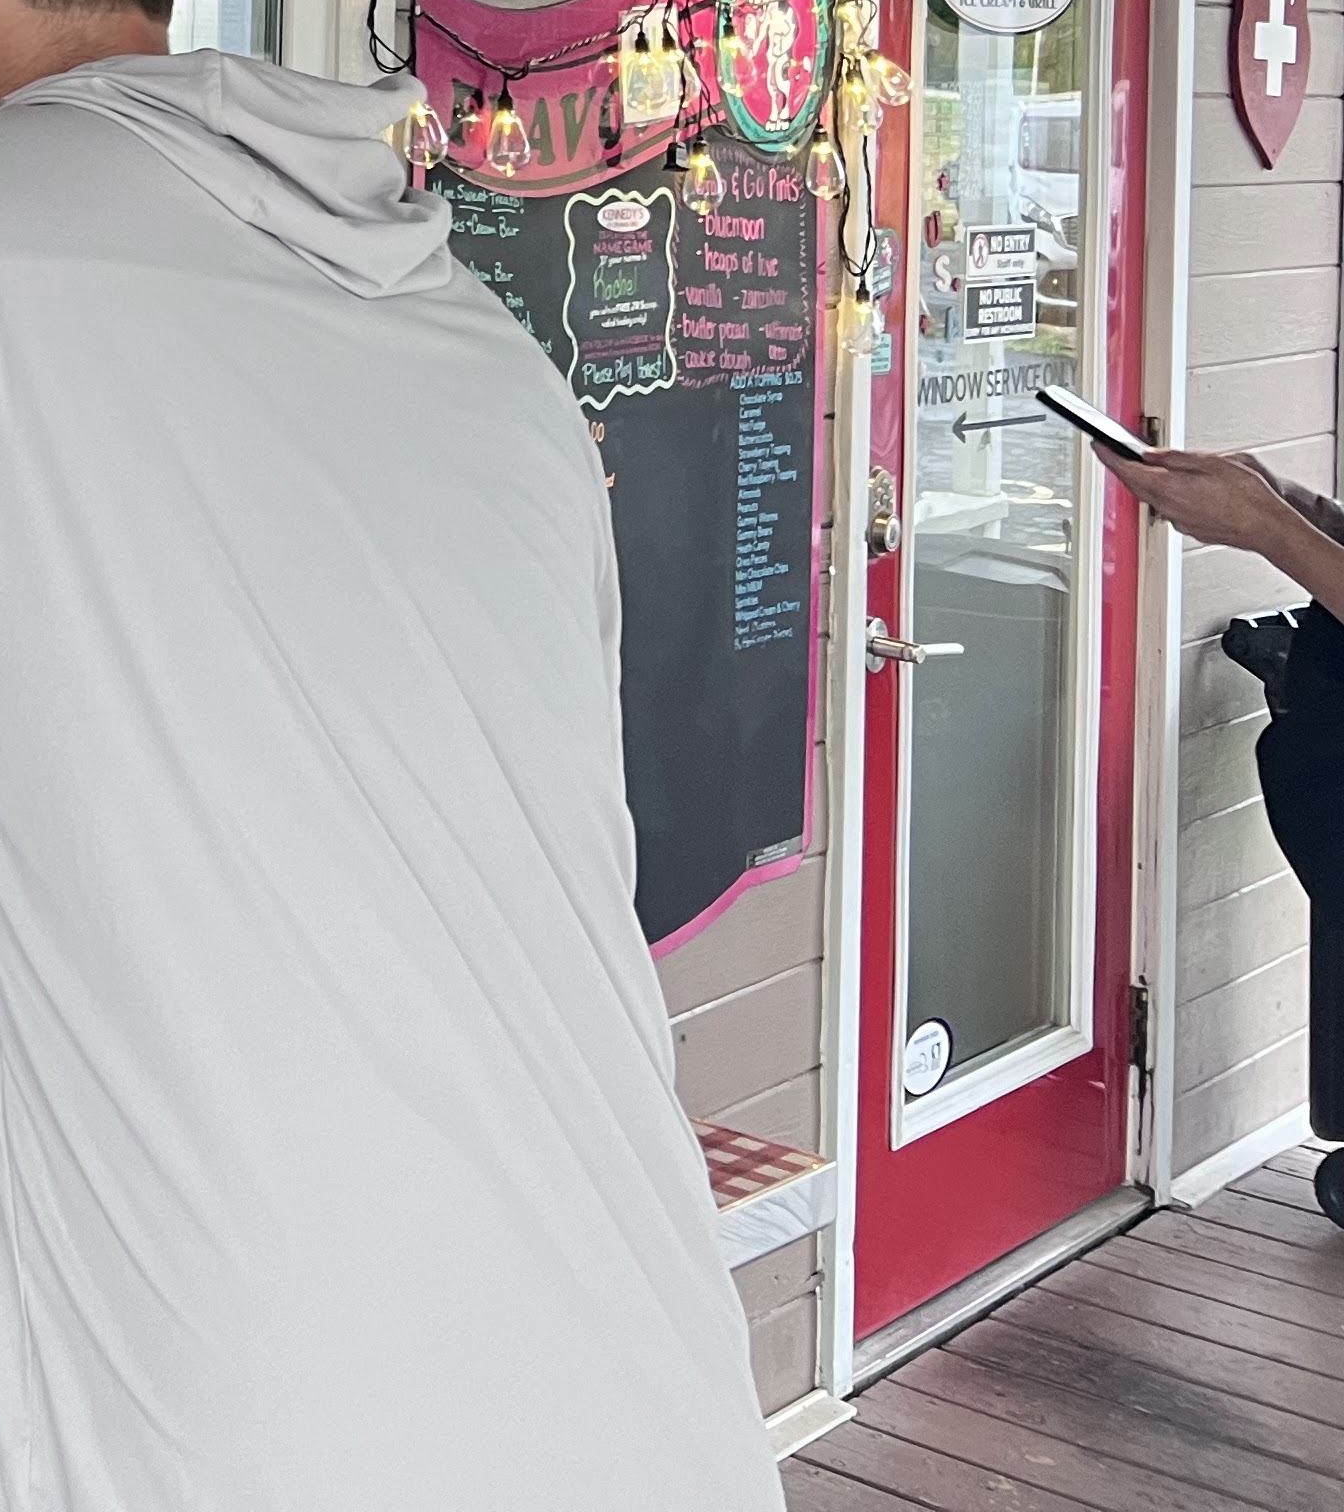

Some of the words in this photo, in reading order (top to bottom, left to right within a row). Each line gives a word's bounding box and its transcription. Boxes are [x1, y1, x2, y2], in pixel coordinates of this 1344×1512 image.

[991, 236, 1002, 252] NO
[1004, 235, 1031, 251] ENTRY
[979, 290, 992, 305] NO
[993, 288, 1022, 303] PUBLIC
[978, 306, 1022, 324] RESTROOM
[917, 371, 984, 407] WINDOW
[987, 364, 1041, 397] SERVICE
